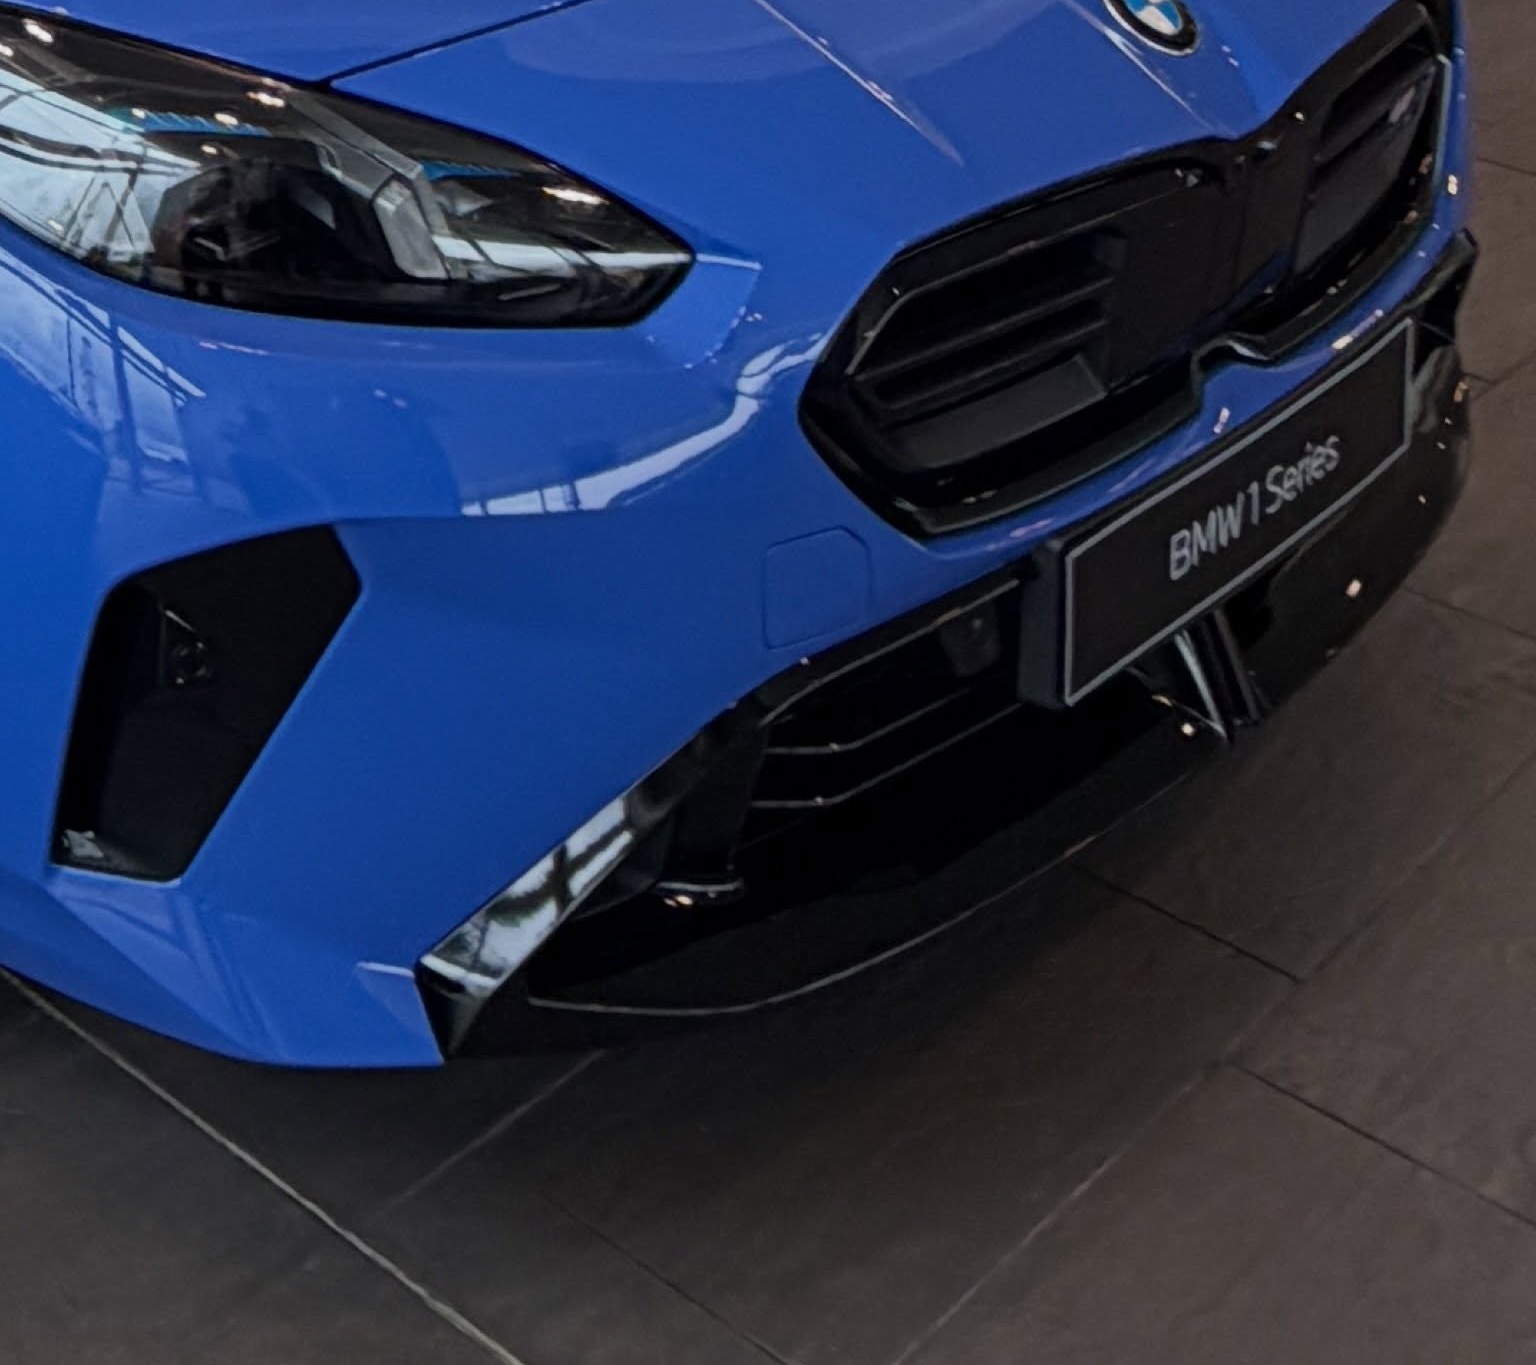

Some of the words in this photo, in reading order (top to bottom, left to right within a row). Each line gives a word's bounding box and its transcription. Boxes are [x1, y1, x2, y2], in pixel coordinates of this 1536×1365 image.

[1169, 491, 1245, 581] BMW
[1246, 480, 1260, 526] 1
[1265, 434, 1340, 514] Series
